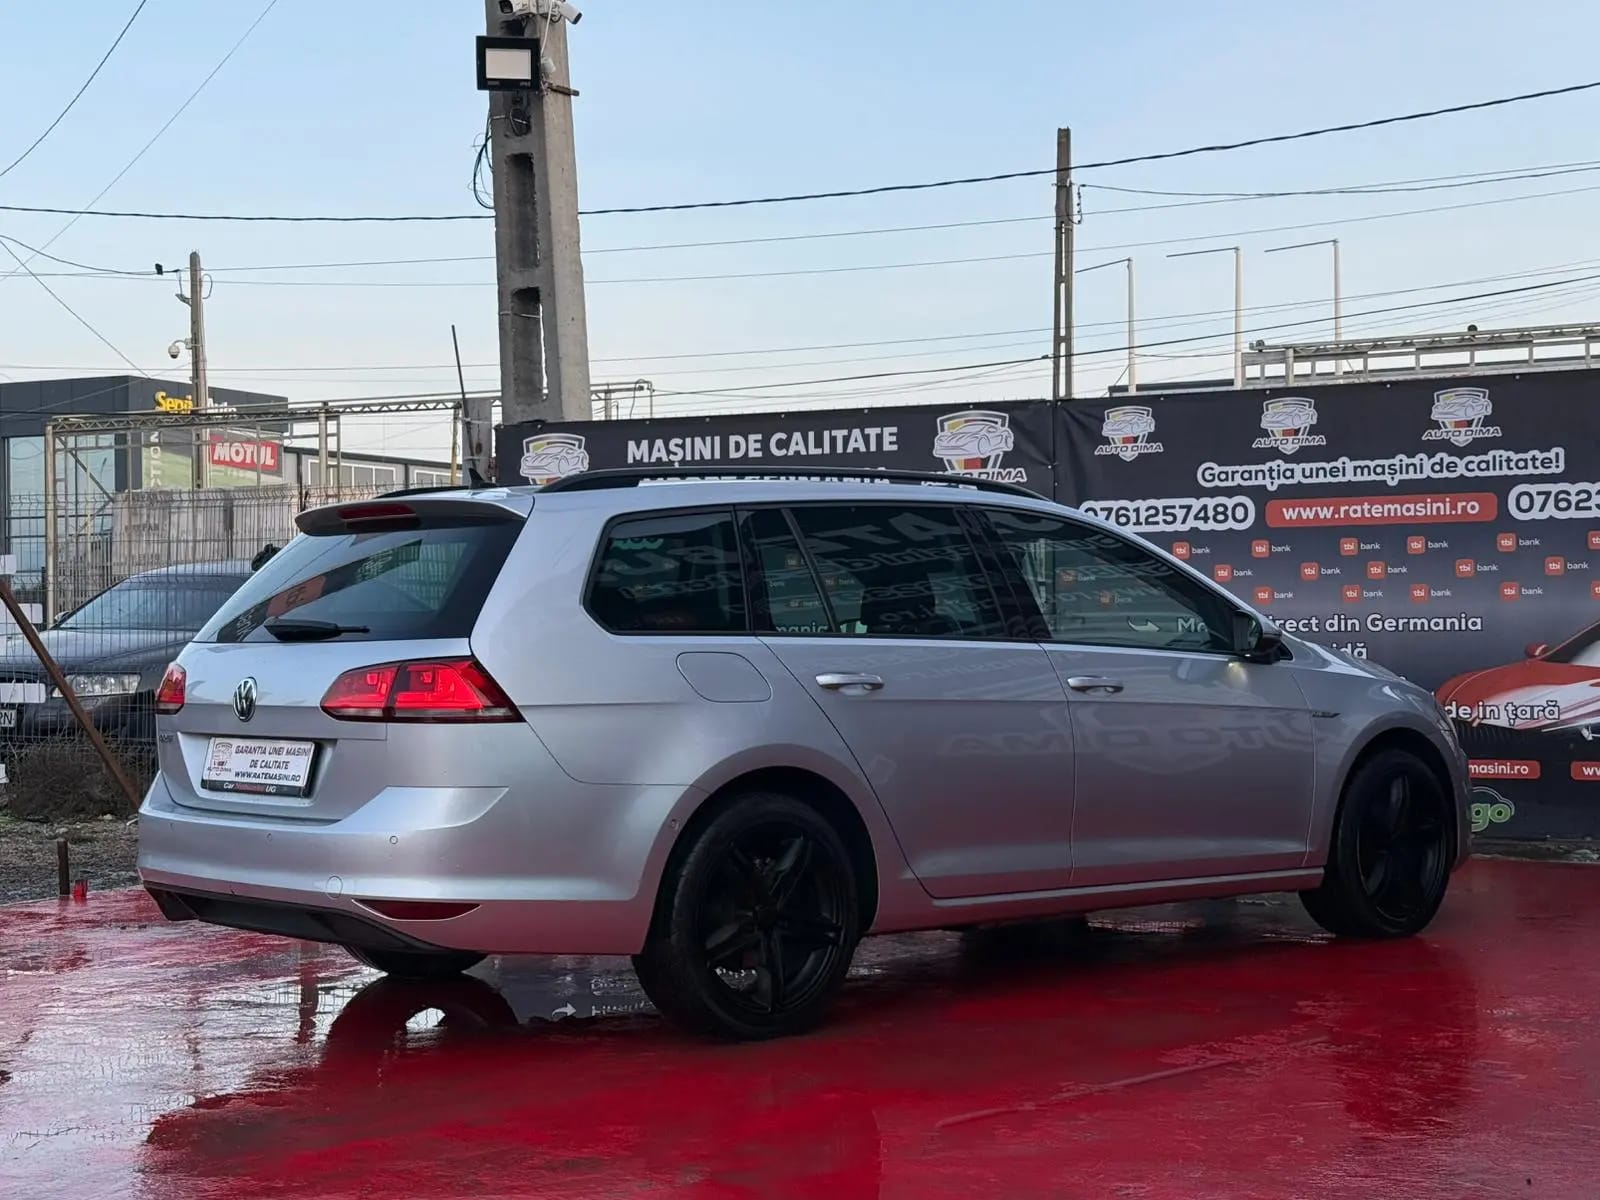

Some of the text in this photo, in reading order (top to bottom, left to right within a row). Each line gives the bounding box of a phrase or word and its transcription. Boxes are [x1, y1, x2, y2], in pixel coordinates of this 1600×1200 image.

[1423, 427, 1500, 440] AUTO DIMA
[729, 434, 762, 459] DE
[769, 427, 898, 457] CALITATE
[1254, 435, 1326, 447] AUTO DIMA
[1096, 443, 1163, 454] AUTO DIMA
[213, 442, 275, 466] MOTUL
[1301, 461, 1346, 479] unei
[1430, 457, 1458, 473] de
[1464, 451, 1560, 473] calitate!
[1515, 488, 1600, 514] 0762
[1282, 498, 1480, 520] www.ratemasini.ro
[1360, 541, 1380, 550] bank
[1410, 540, 1448, 549] tbi bank
[1501, 537, 1540, 546] tbi bank
[1192, 546, 1210, 554] bank
[1255, 544, 1291, 553] tbi bank
[1370, 565, 1408, 574] tbi bank
[1459, 563, 1498, 572] tbi bank
[1549, 561, 1588, 570] tbi bank
[1217, 568, 1253, 577] tbi bank
[1304, 566, 1341, 575] tbi bank
[1257, 591, 1294, 599] tbi bank
[1346, 589, 1383, 597] tbi bank
[1412, 588, 1451, 597] tbi bank
[1503, 586, 1543, 595] tbi bank
[1268, 615, 1319, 632] rect
[1325, 614, 1360, 632] din
[1366, 613, 1483, 632] Germania
[1478, 702, 1499, 719] in
[234, 745, 311, 757] GARANTIA UNEI MASINI
[249, 760, 290, 770] DE CALITATE
[1468, 762, 1529, 775] masini.ro
[1471, 803, 1511, 832] go
